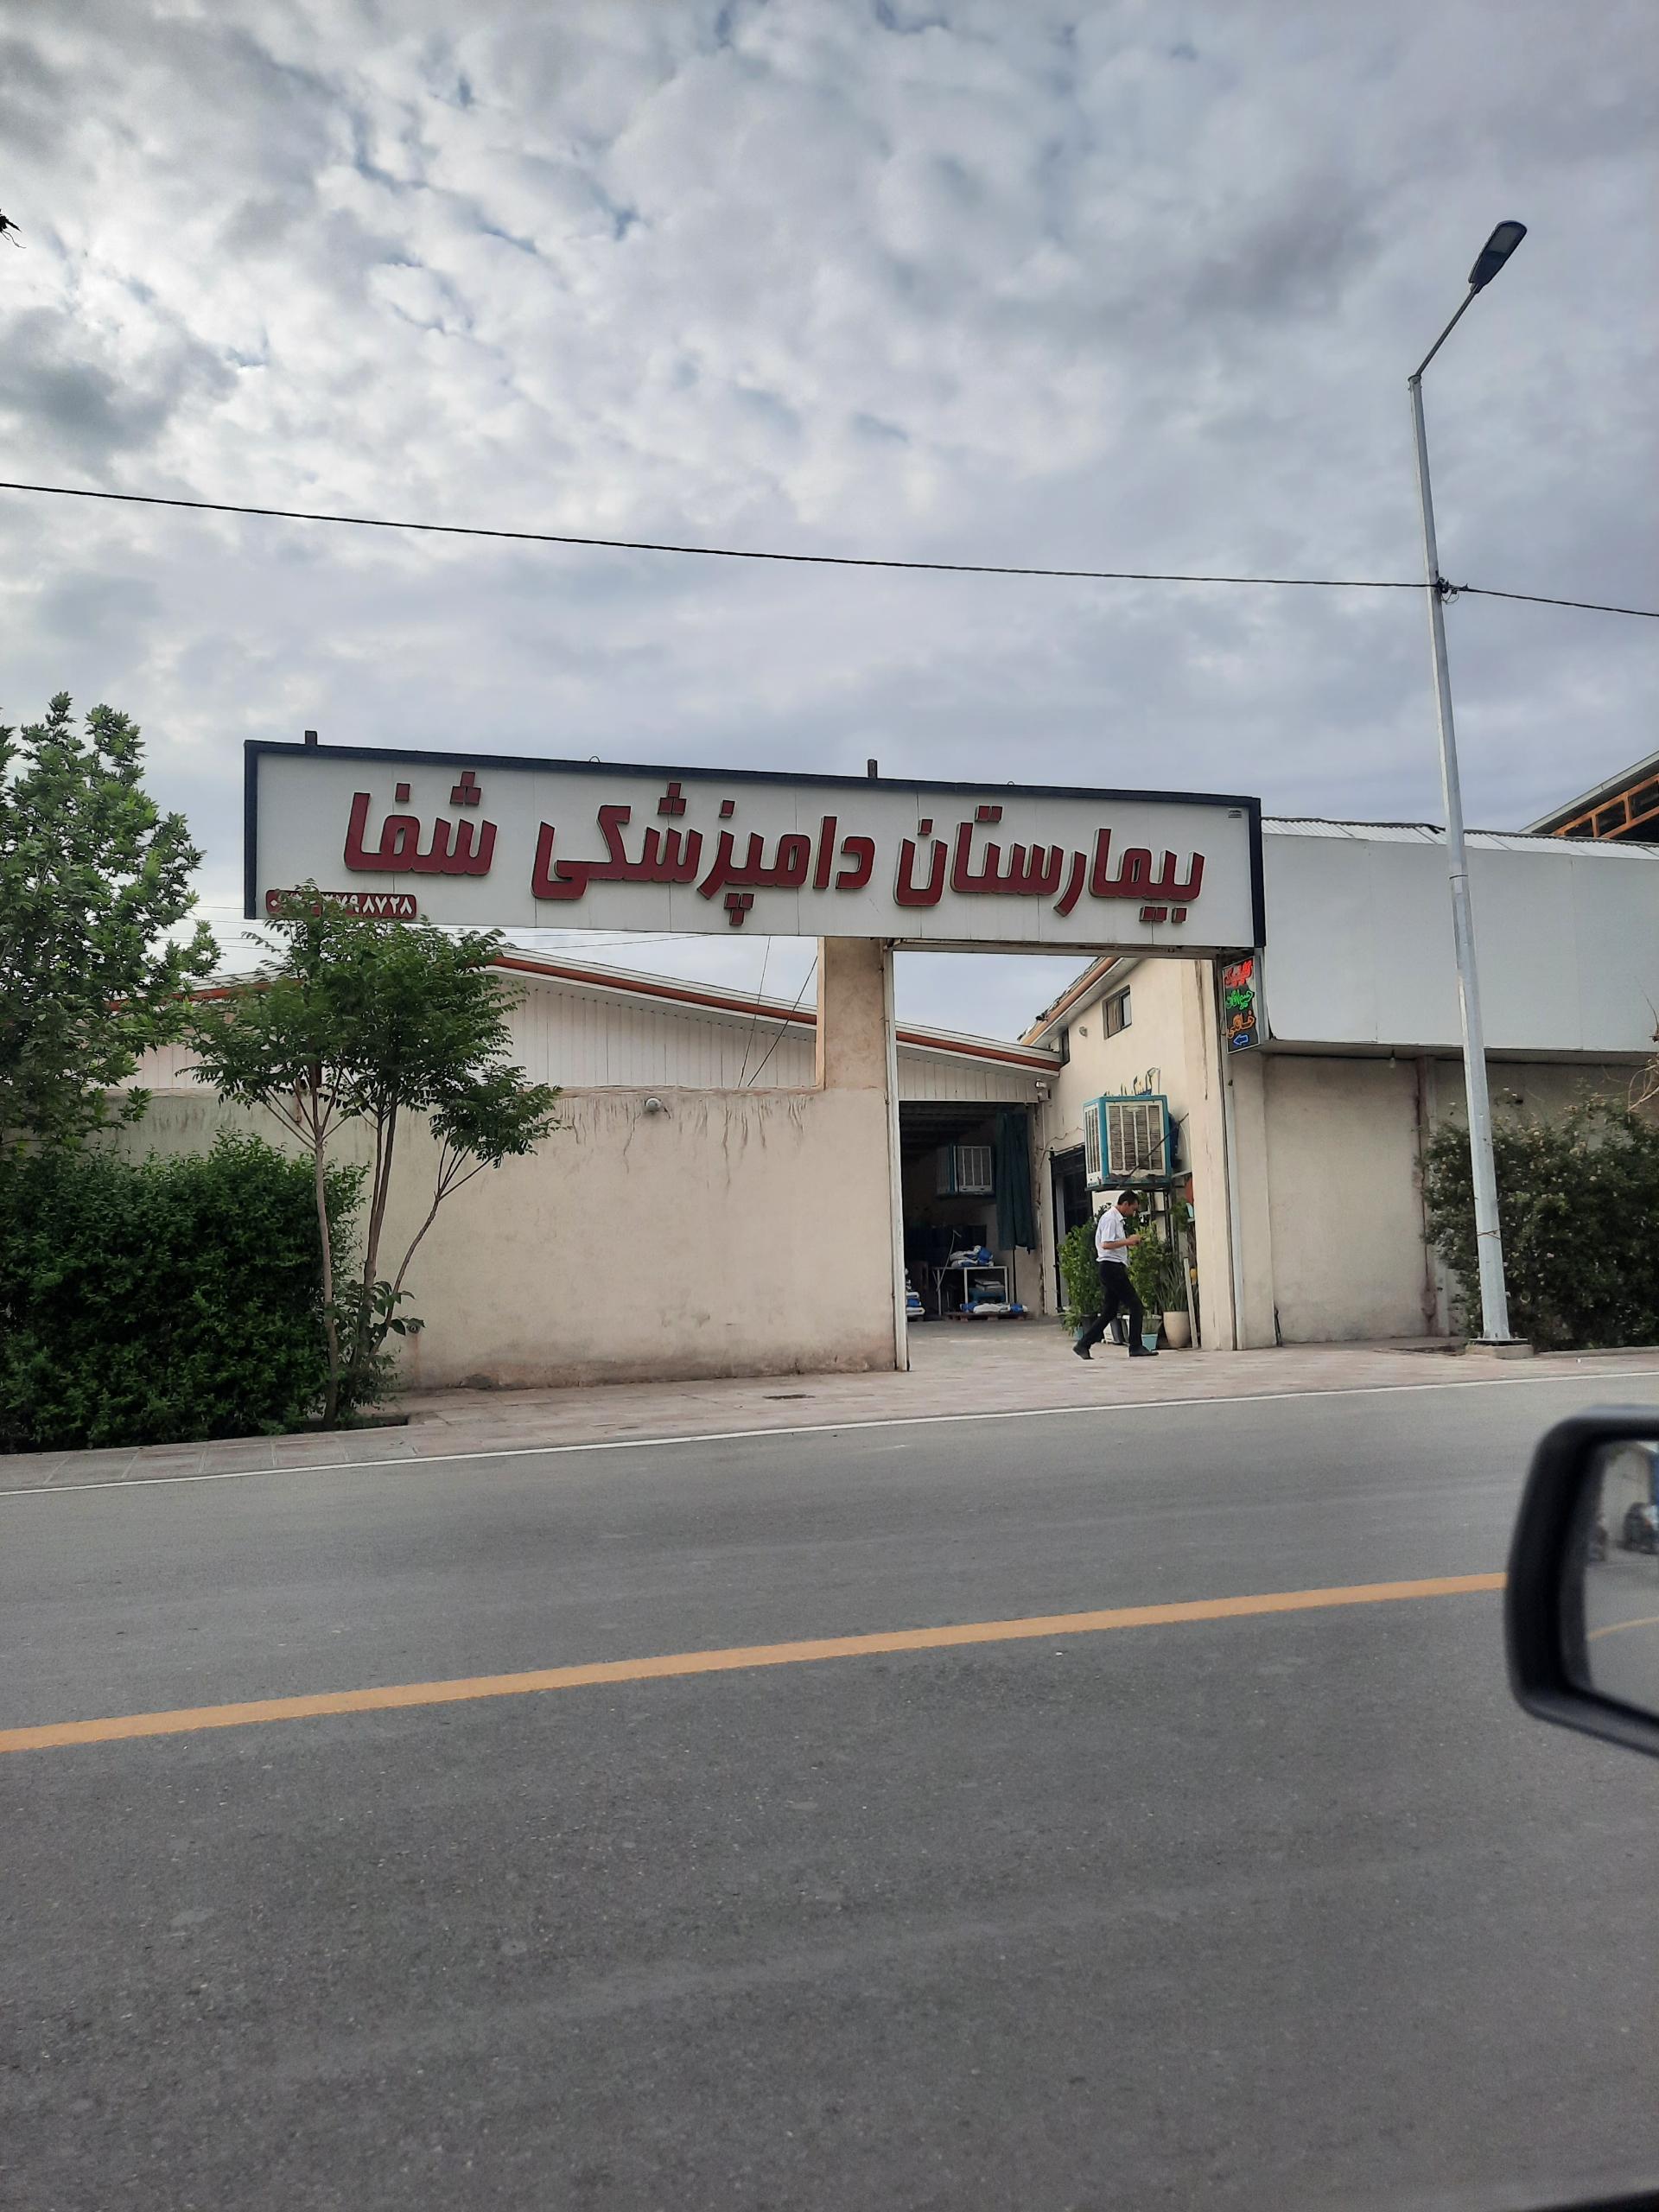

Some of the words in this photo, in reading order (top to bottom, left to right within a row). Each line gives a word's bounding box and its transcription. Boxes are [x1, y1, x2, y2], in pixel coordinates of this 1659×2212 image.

[343, 772, 499, 876] شفا
[531, 782, 877, 926] دامپزشکی
[893, 805, 1205, 924] بیمارستان
[1226, 1010, 1255, 1039] خانگی
